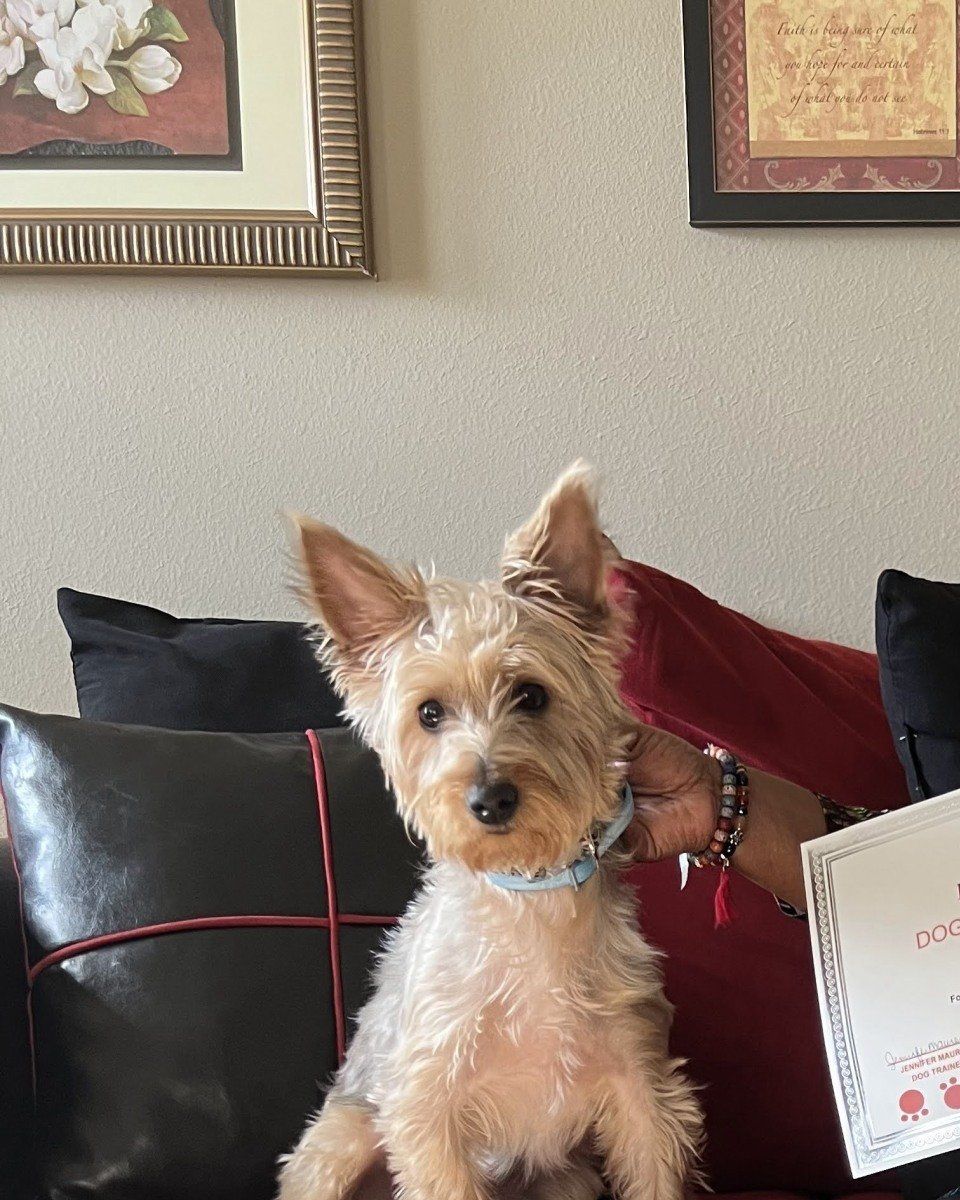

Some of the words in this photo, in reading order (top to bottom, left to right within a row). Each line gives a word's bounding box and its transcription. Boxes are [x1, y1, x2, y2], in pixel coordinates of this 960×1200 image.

[777, 15, 815, 35] Faith
[810, 27, 819, 35] is
[822, 15, 849, 48] being
[853, 27, 871, 35] sure
[867, 14, 897, 49] of
[891, 14, 918, 35] what
[777, 61, 801, 80] you
[805, 49, 829, 82] hope
[817, 48, 848, 84] for
[851, 49, 880, 69] and
[874, 58, 909, 69] certain
[781, 82, 810, 118] of
[805, 82, 833, 104] what
[825, 95, 850, 113] you
[855, 84, 871, 103] do
[872, 91, 890, 103] not
[900, 1056, 937, 1074] JENNIFER
[911, 1070, 930, 1082] DOG
